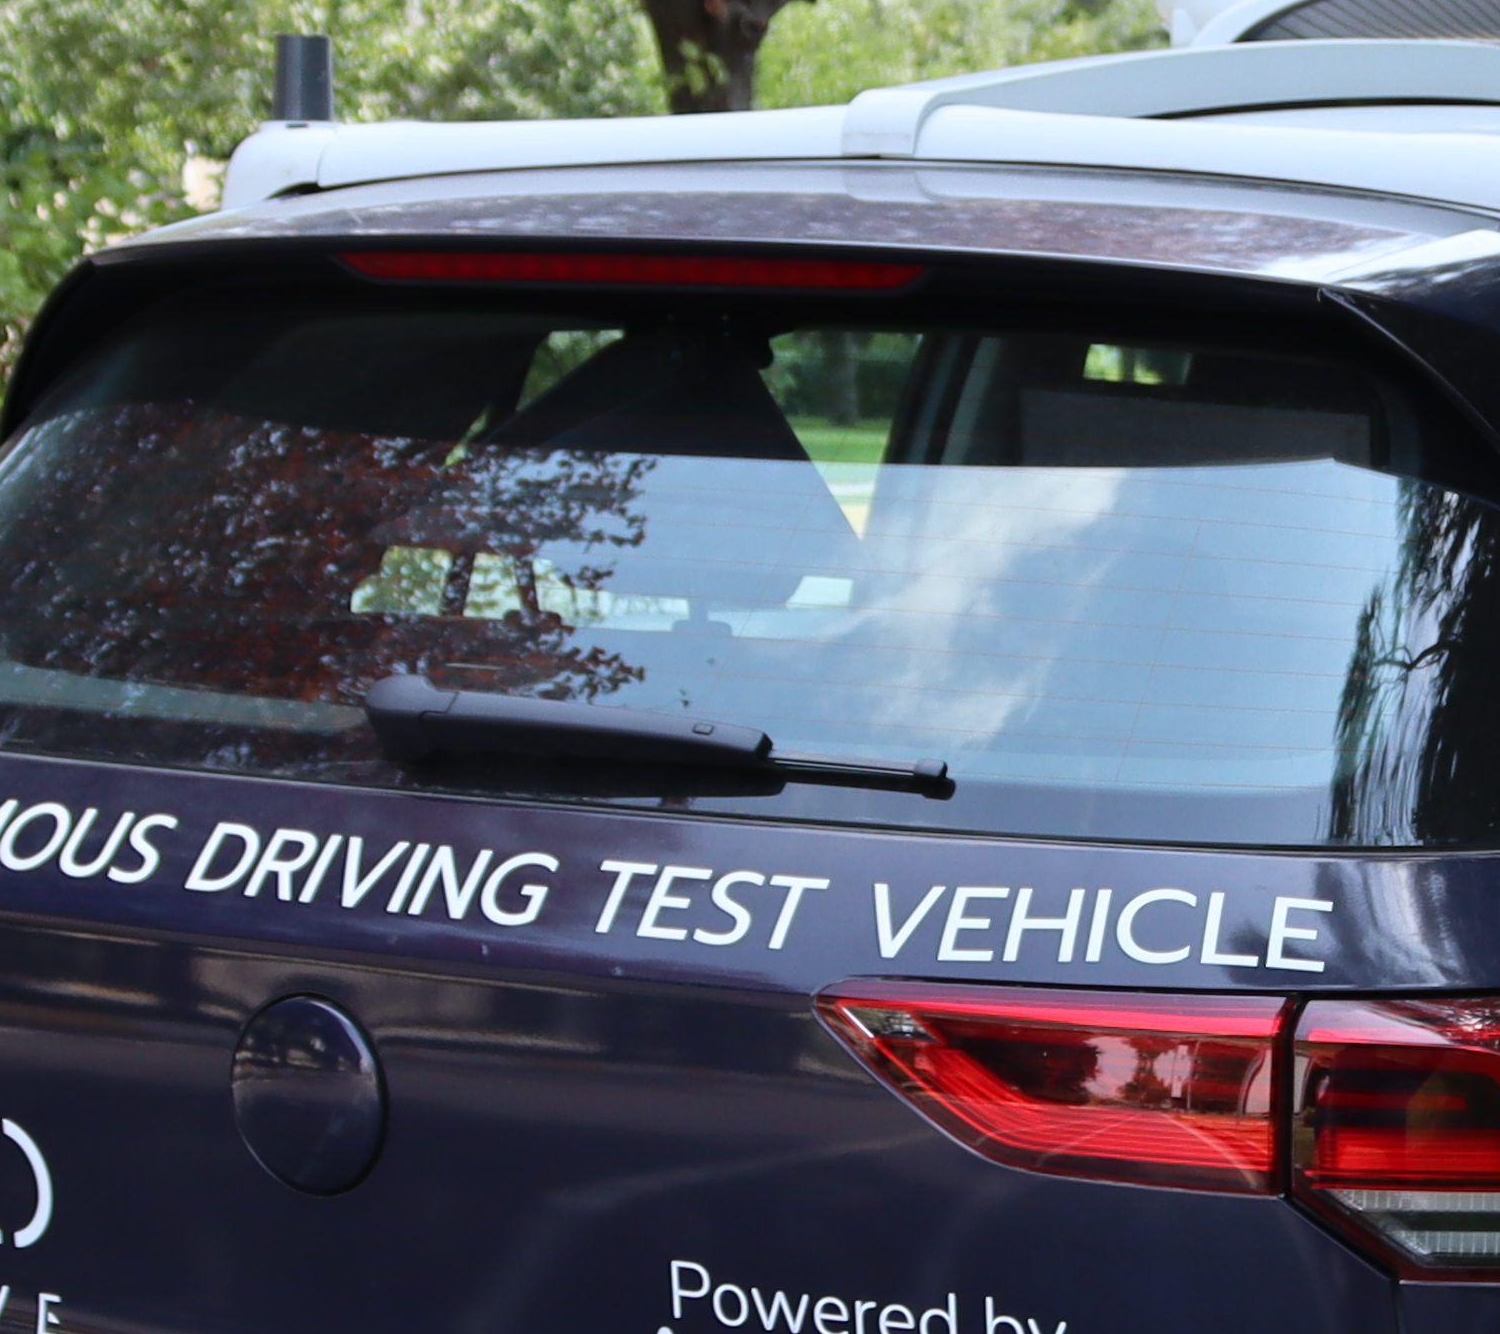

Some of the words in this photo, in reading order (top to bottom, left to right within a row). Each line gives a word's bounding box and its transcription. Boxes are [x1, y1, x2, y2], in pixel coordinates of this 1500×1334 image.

[184, 822, 560, 926] DRIVING
[595, 859, 831, 951] TEST
[873, 882, 1334, 973] VEHICLE
